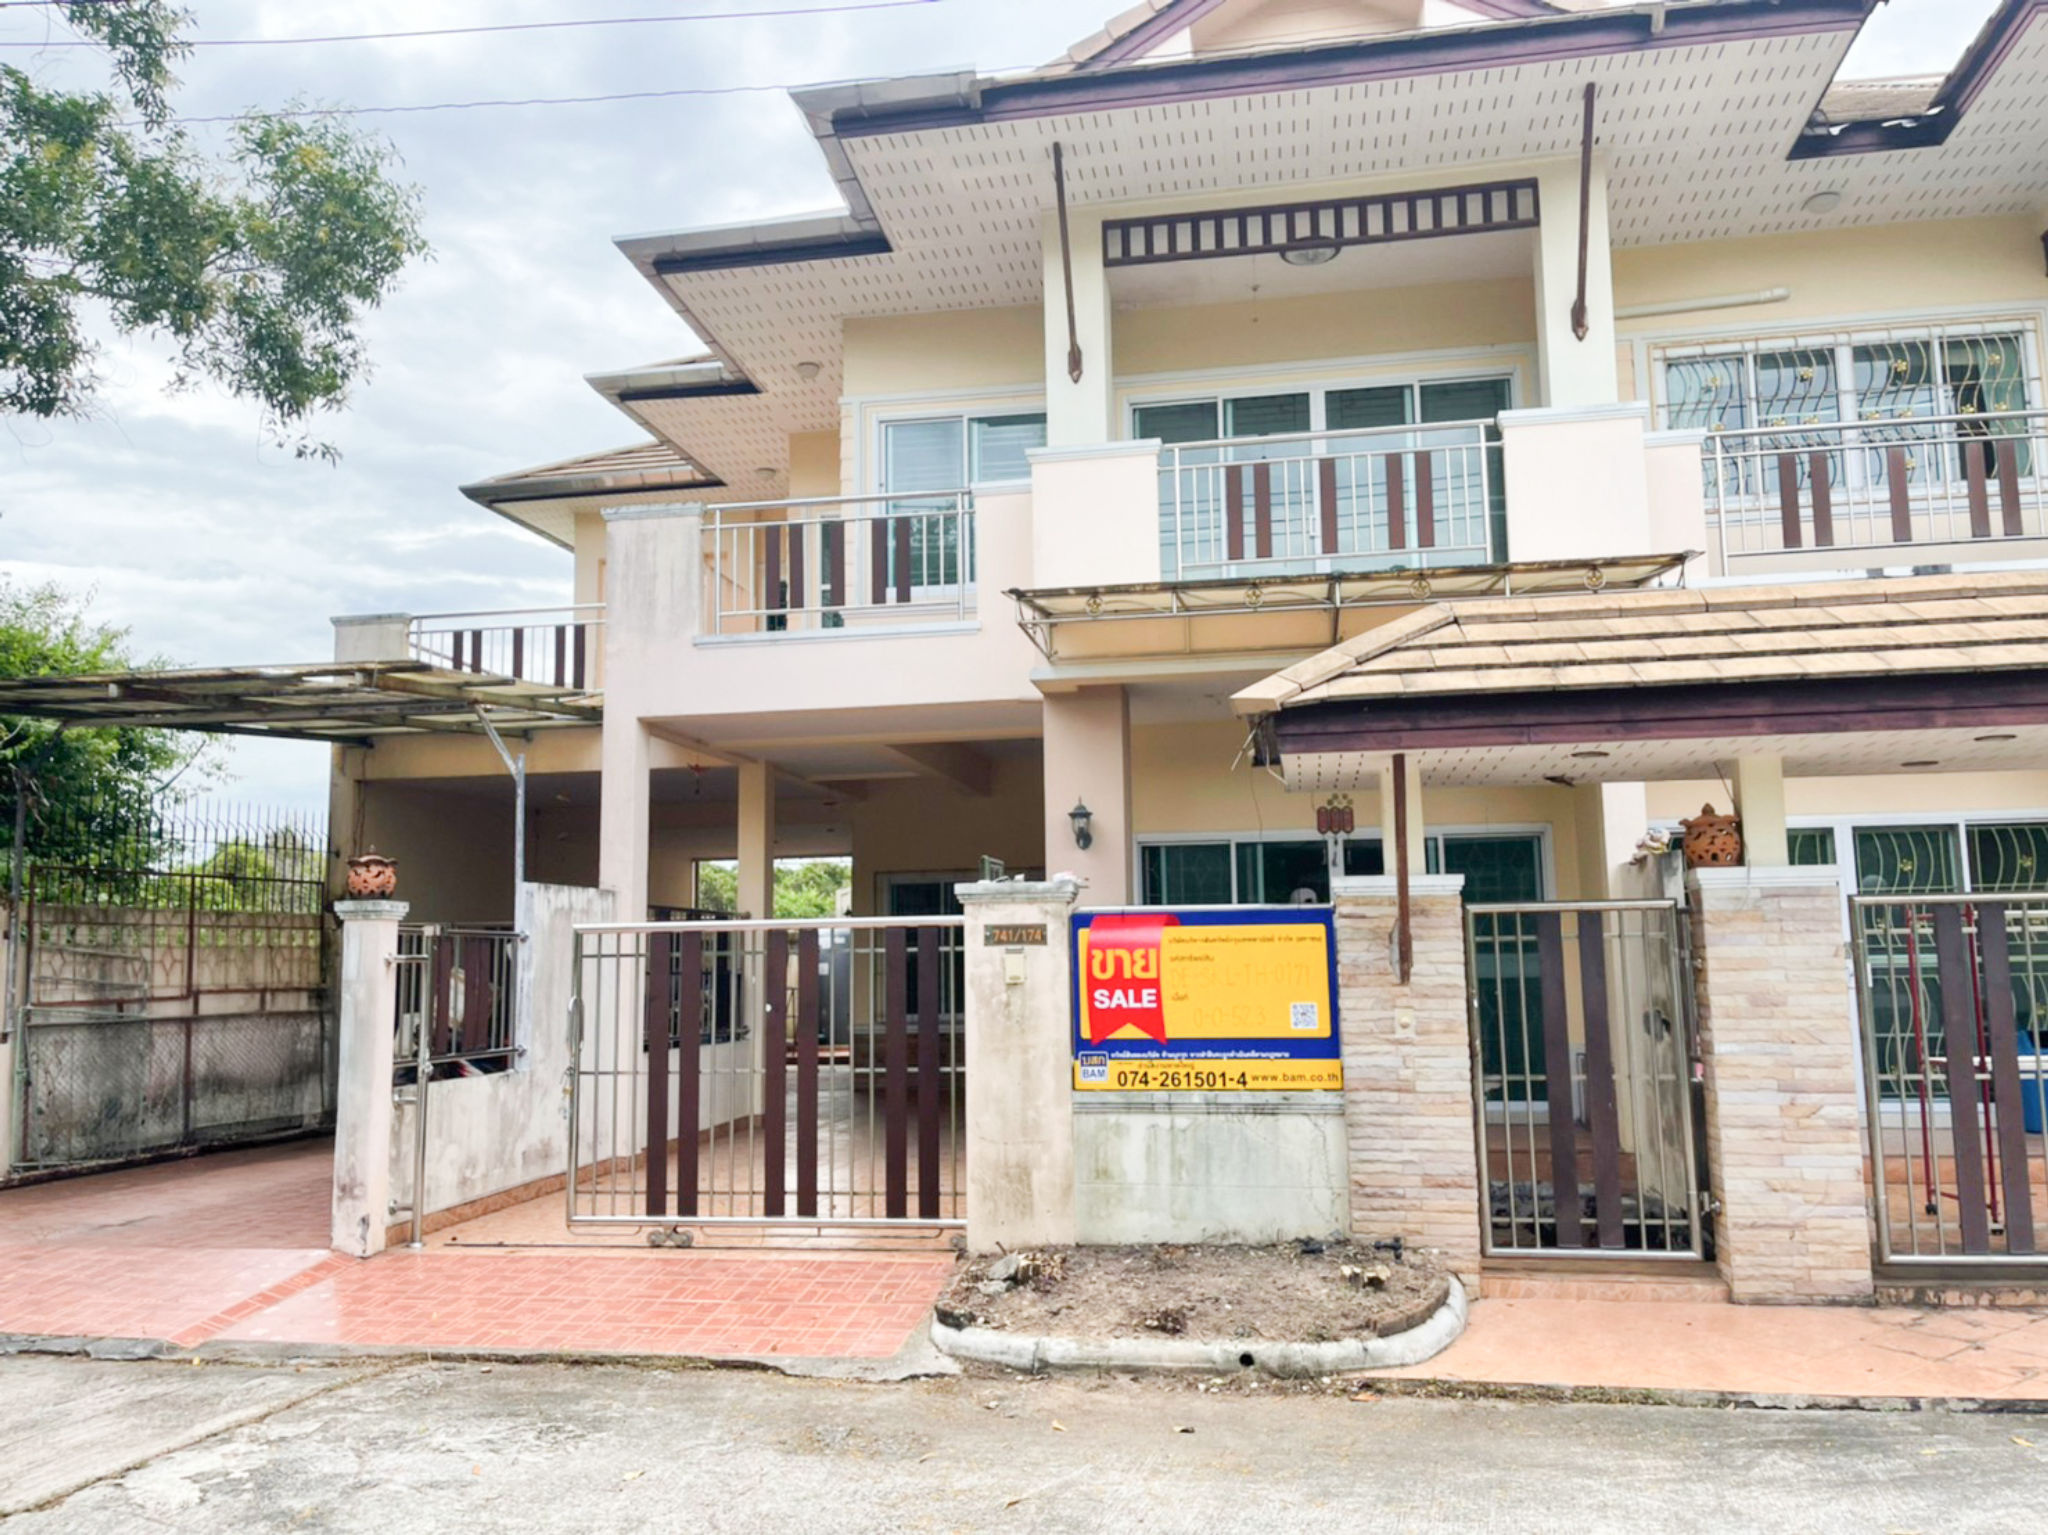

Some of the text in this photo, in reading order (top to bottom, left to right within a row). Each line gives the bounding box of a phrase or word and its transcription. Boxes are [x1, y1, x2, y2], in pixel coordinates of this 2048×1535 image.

[992, 928, 1043, 942] 741/174
[1091, 948, 1158, 980] ขาย
[1093, 988, 1158, 1010] SALE
[1082, 1068, 1106, 1079] BAM
[1117, 1070, 1248, 1088] 074-261501-4
[1250, 1072, 1340, 1083] www.bam.co.th
